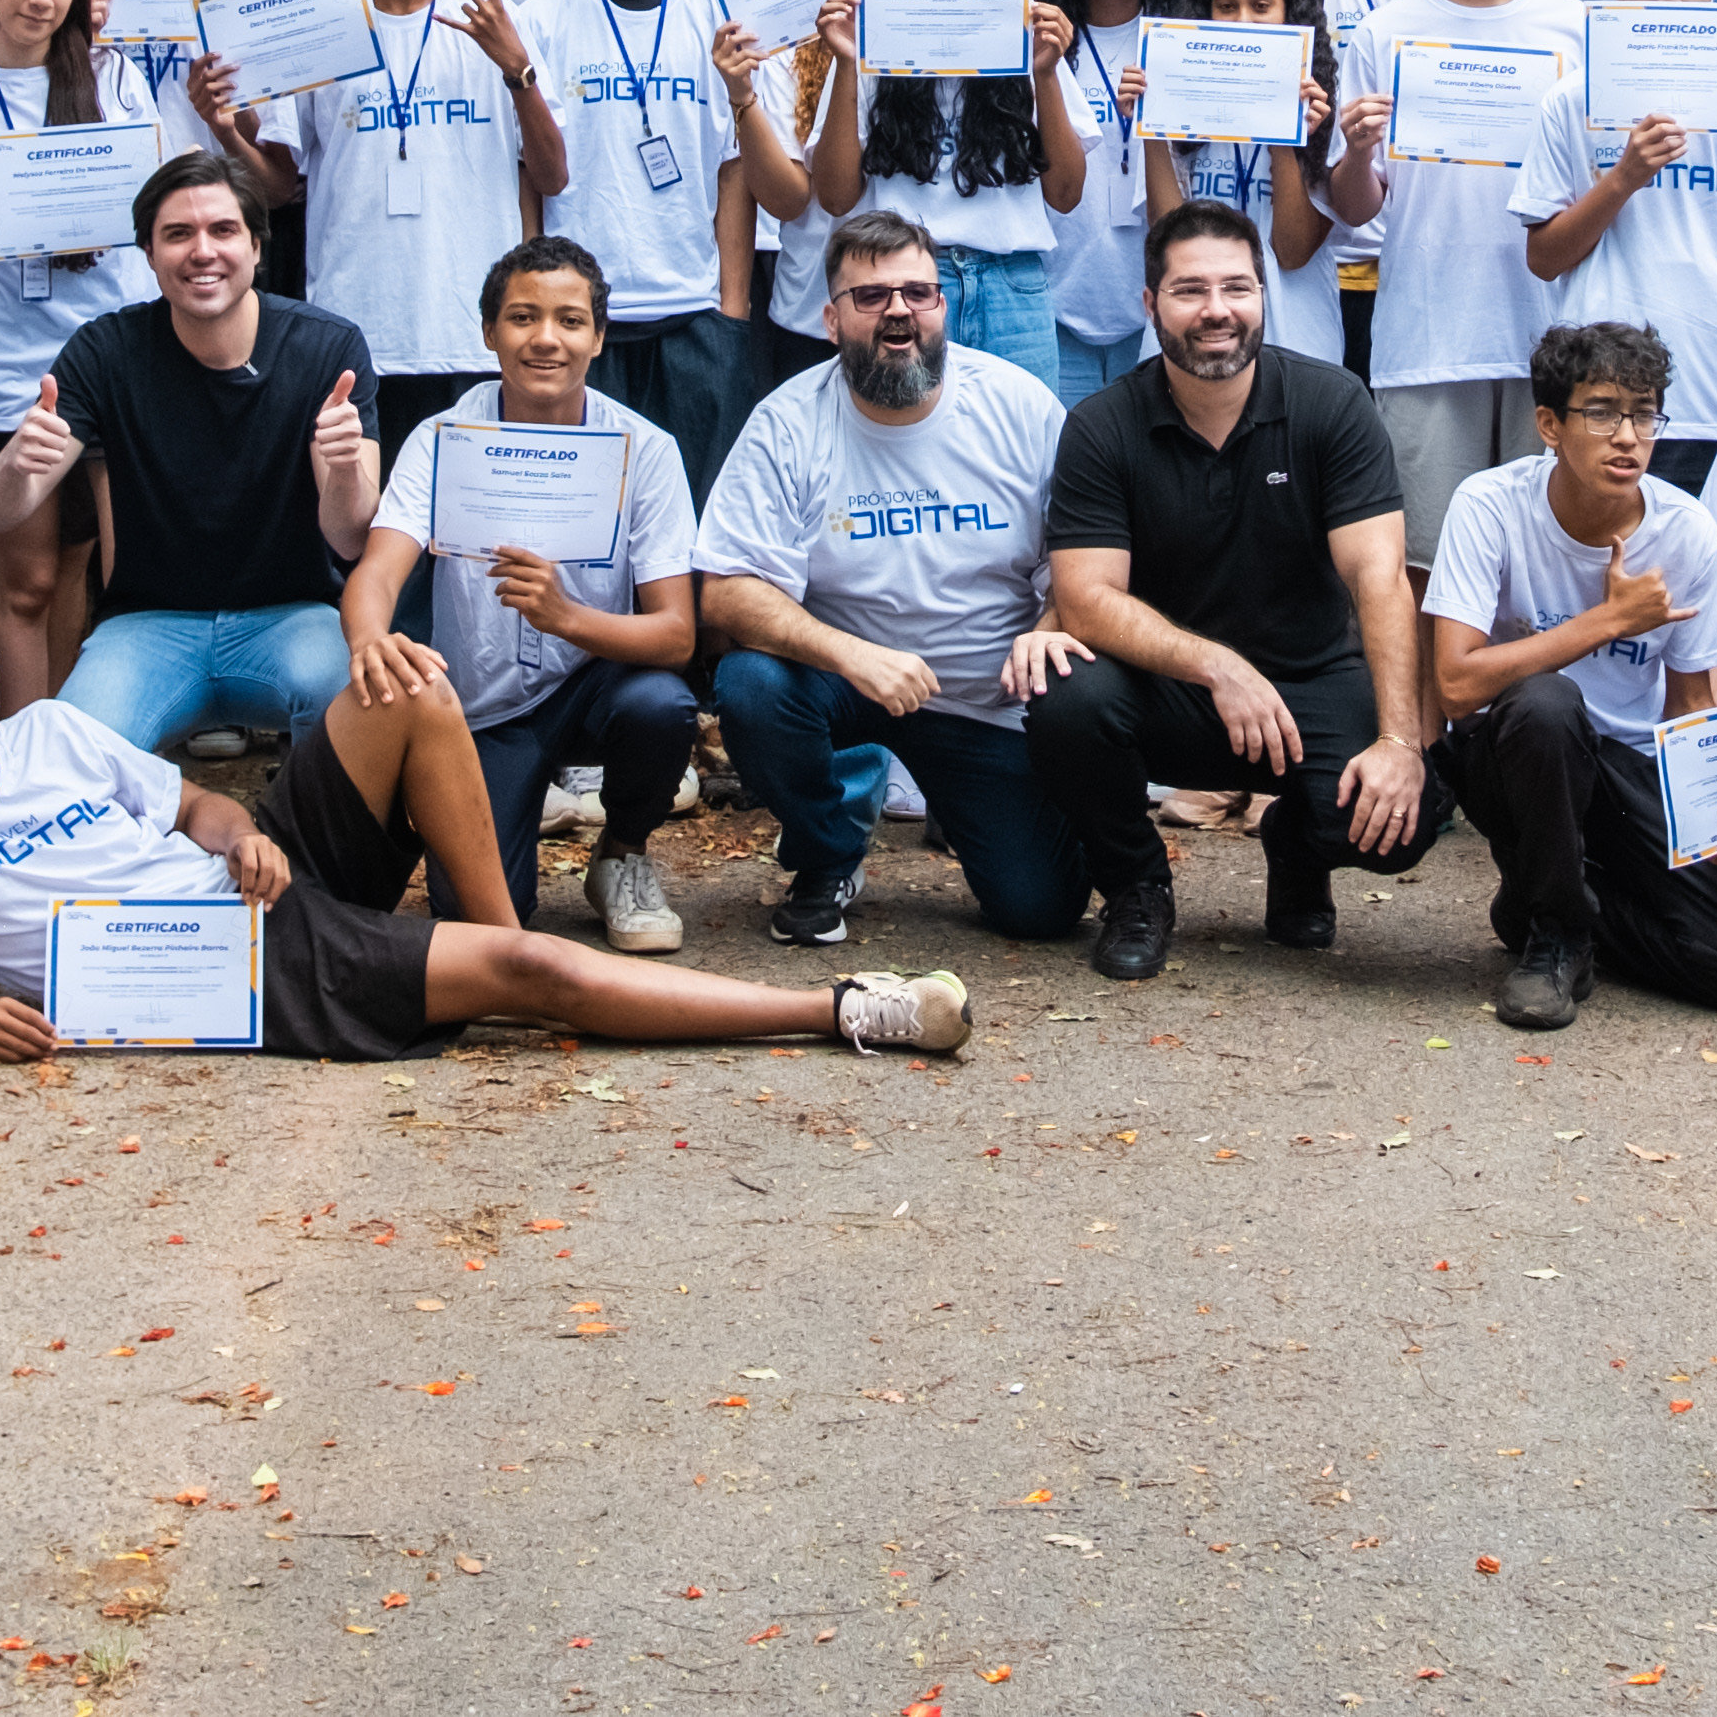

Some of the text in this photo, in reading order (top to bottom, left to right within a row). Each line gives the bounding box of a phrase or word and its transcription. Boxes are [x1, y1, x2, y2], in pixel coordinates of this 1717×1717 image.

[1631, 24, 1717, 34] CERTIFICADO
[1186, 41, 1262, 54] CERTIFICADO
[1439, 61, 1517, 75] CERTIFICADO
[356, 99, 491, 133] DIGITAL
[27, 145, 113, 161] CERTIFICADO
[1191, 171, 1273, 200] DIGTA
[484, 446, 578, 461] CERTIFICADO
[491, 468, 523, 477] Samuel
[848, 489, 940, 508] PRÓ-JOVEM
[849, 503, 1009, 540] DIGITAL
[106, 922, 200, 933] CERTIFICADO
[102, 945, 130, 953] Miguel
